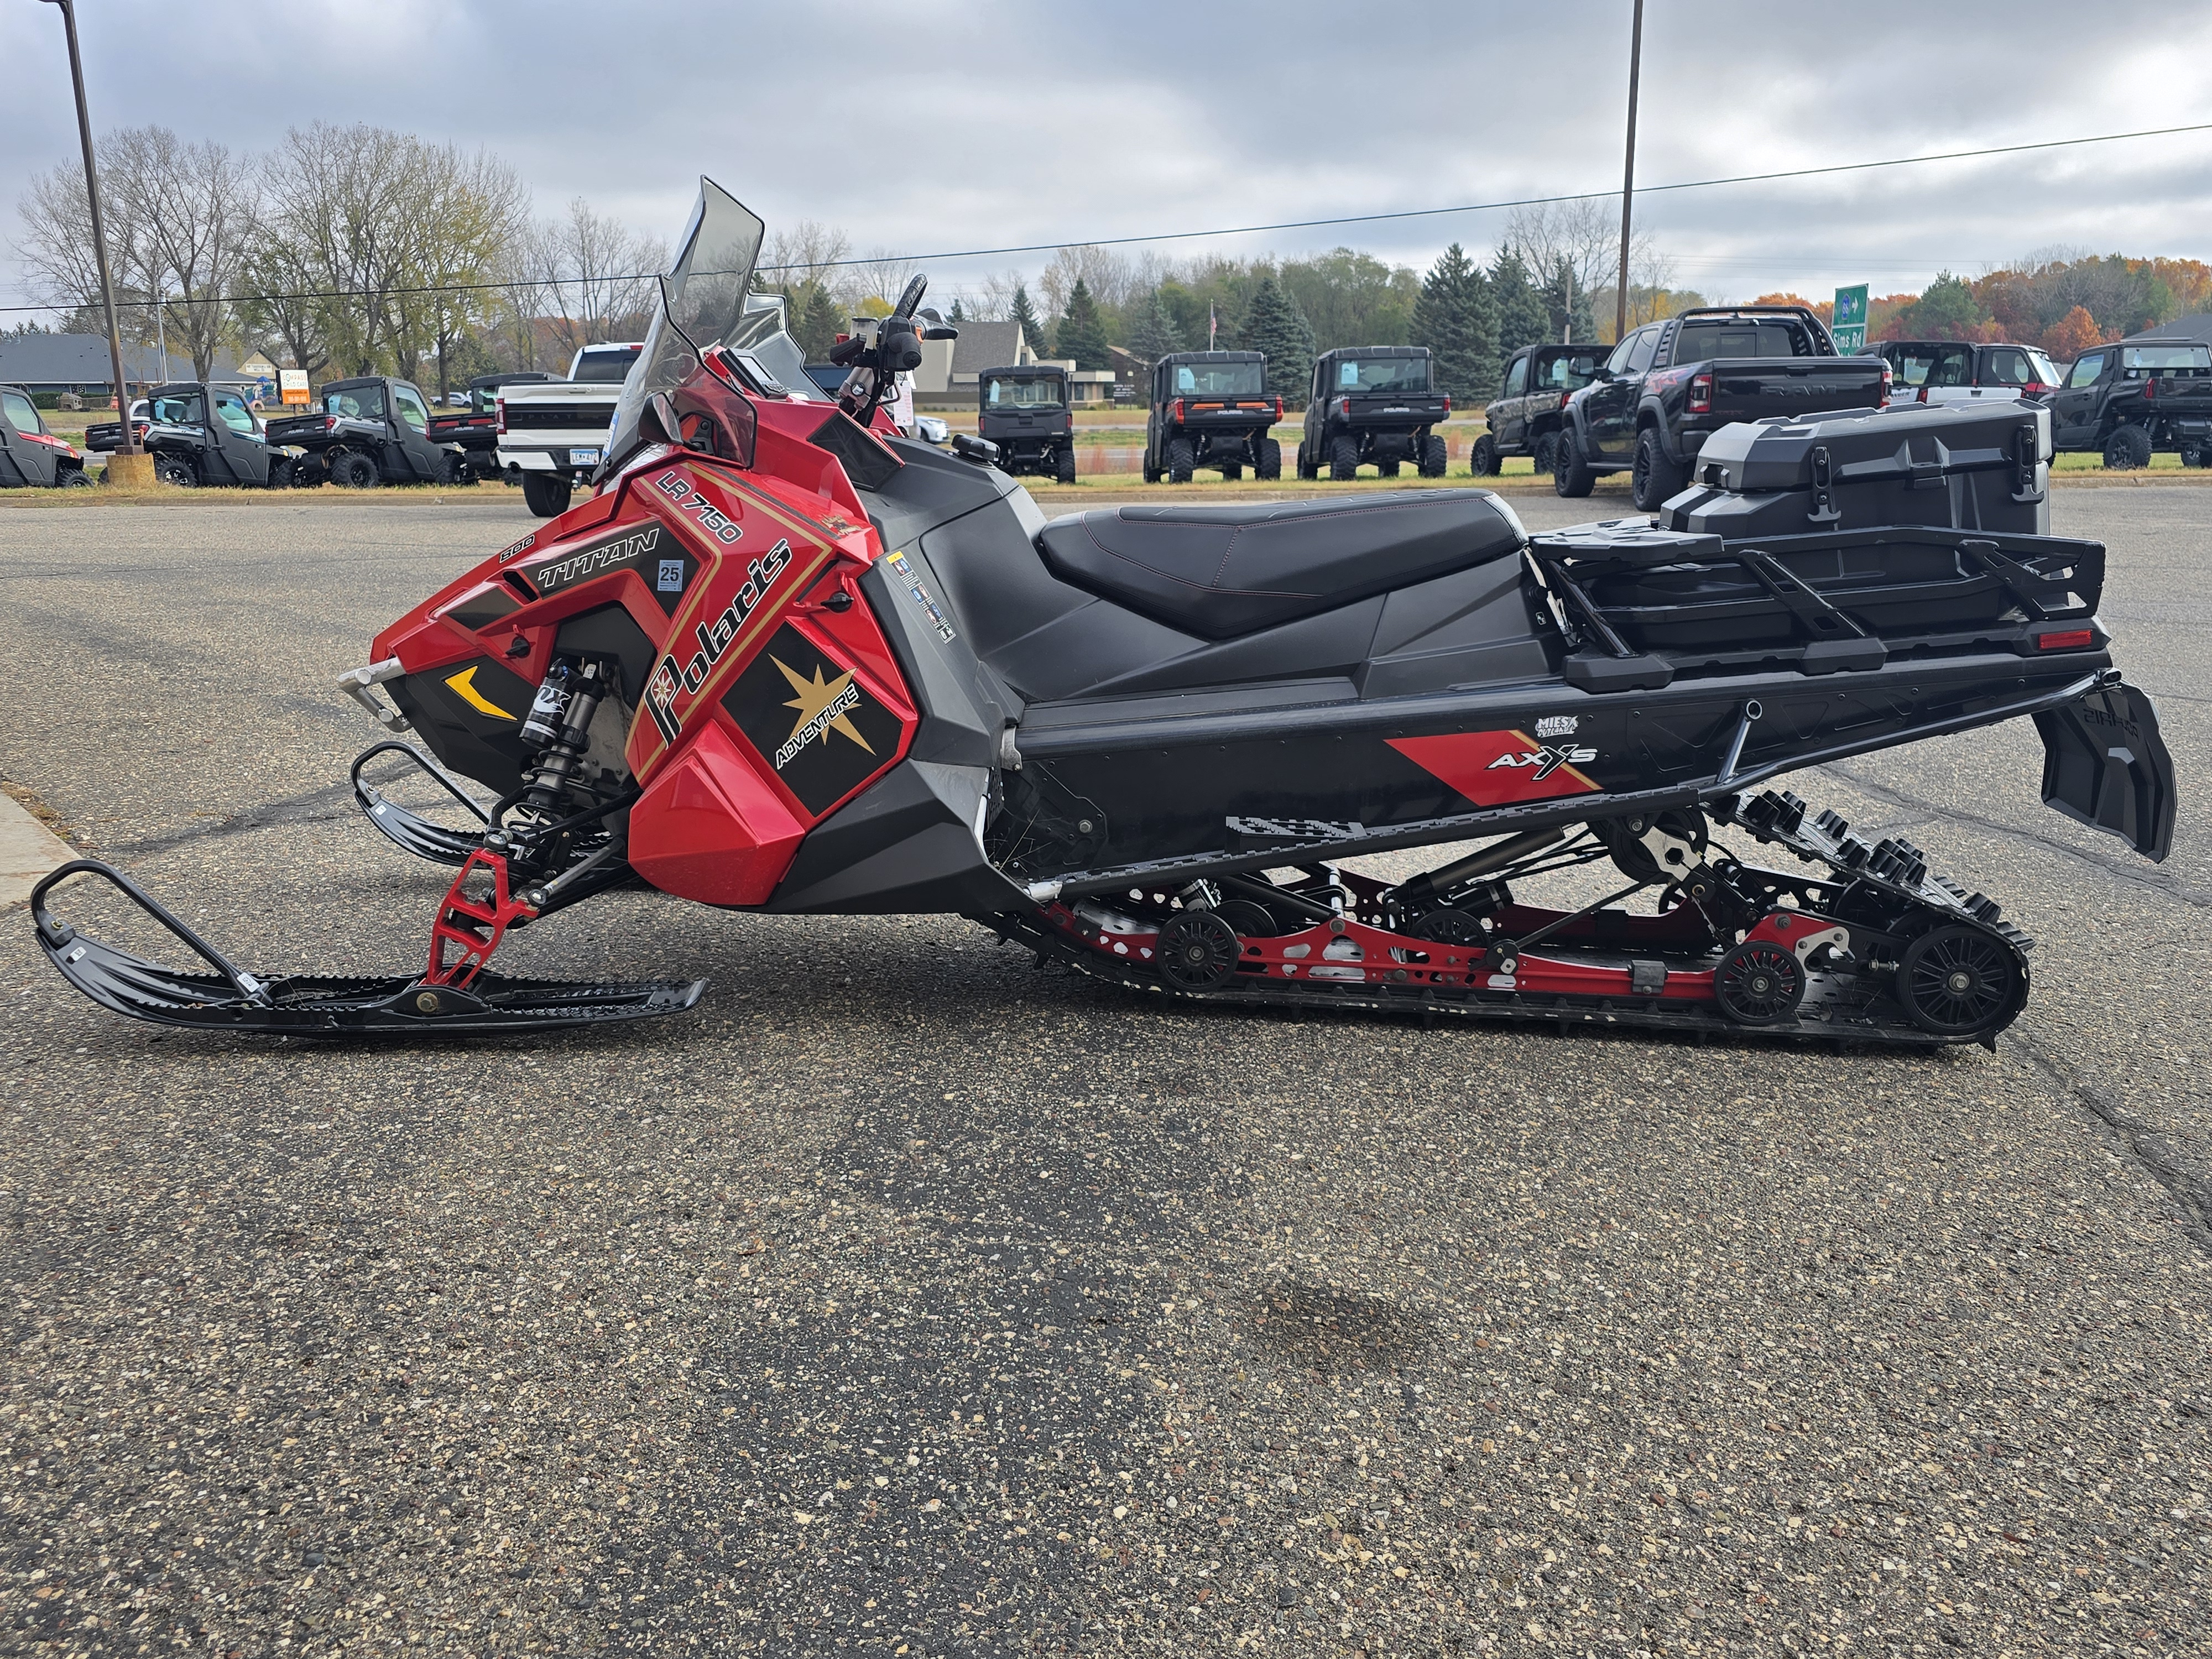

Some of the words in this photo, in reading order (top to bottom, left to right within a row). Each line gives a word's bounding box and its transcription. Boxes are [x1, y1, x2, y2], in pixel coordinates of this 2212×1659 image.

[1834, 332, 1850, 348] Sims
[1852, 332, 1861, 348] Rd
[655, 471, 691, 501] LR
[681, 492, 743, 544] 7150
[499, 534, 535, 563] 800
[538, 528, 659, 588] TITAN
[660, 567, 679, 581] 25
[644, 539, 792, 750] Polaris
[776, 684, 859, 770] ADVENTURE
[1488, 744, 1598, 780] AXYS
